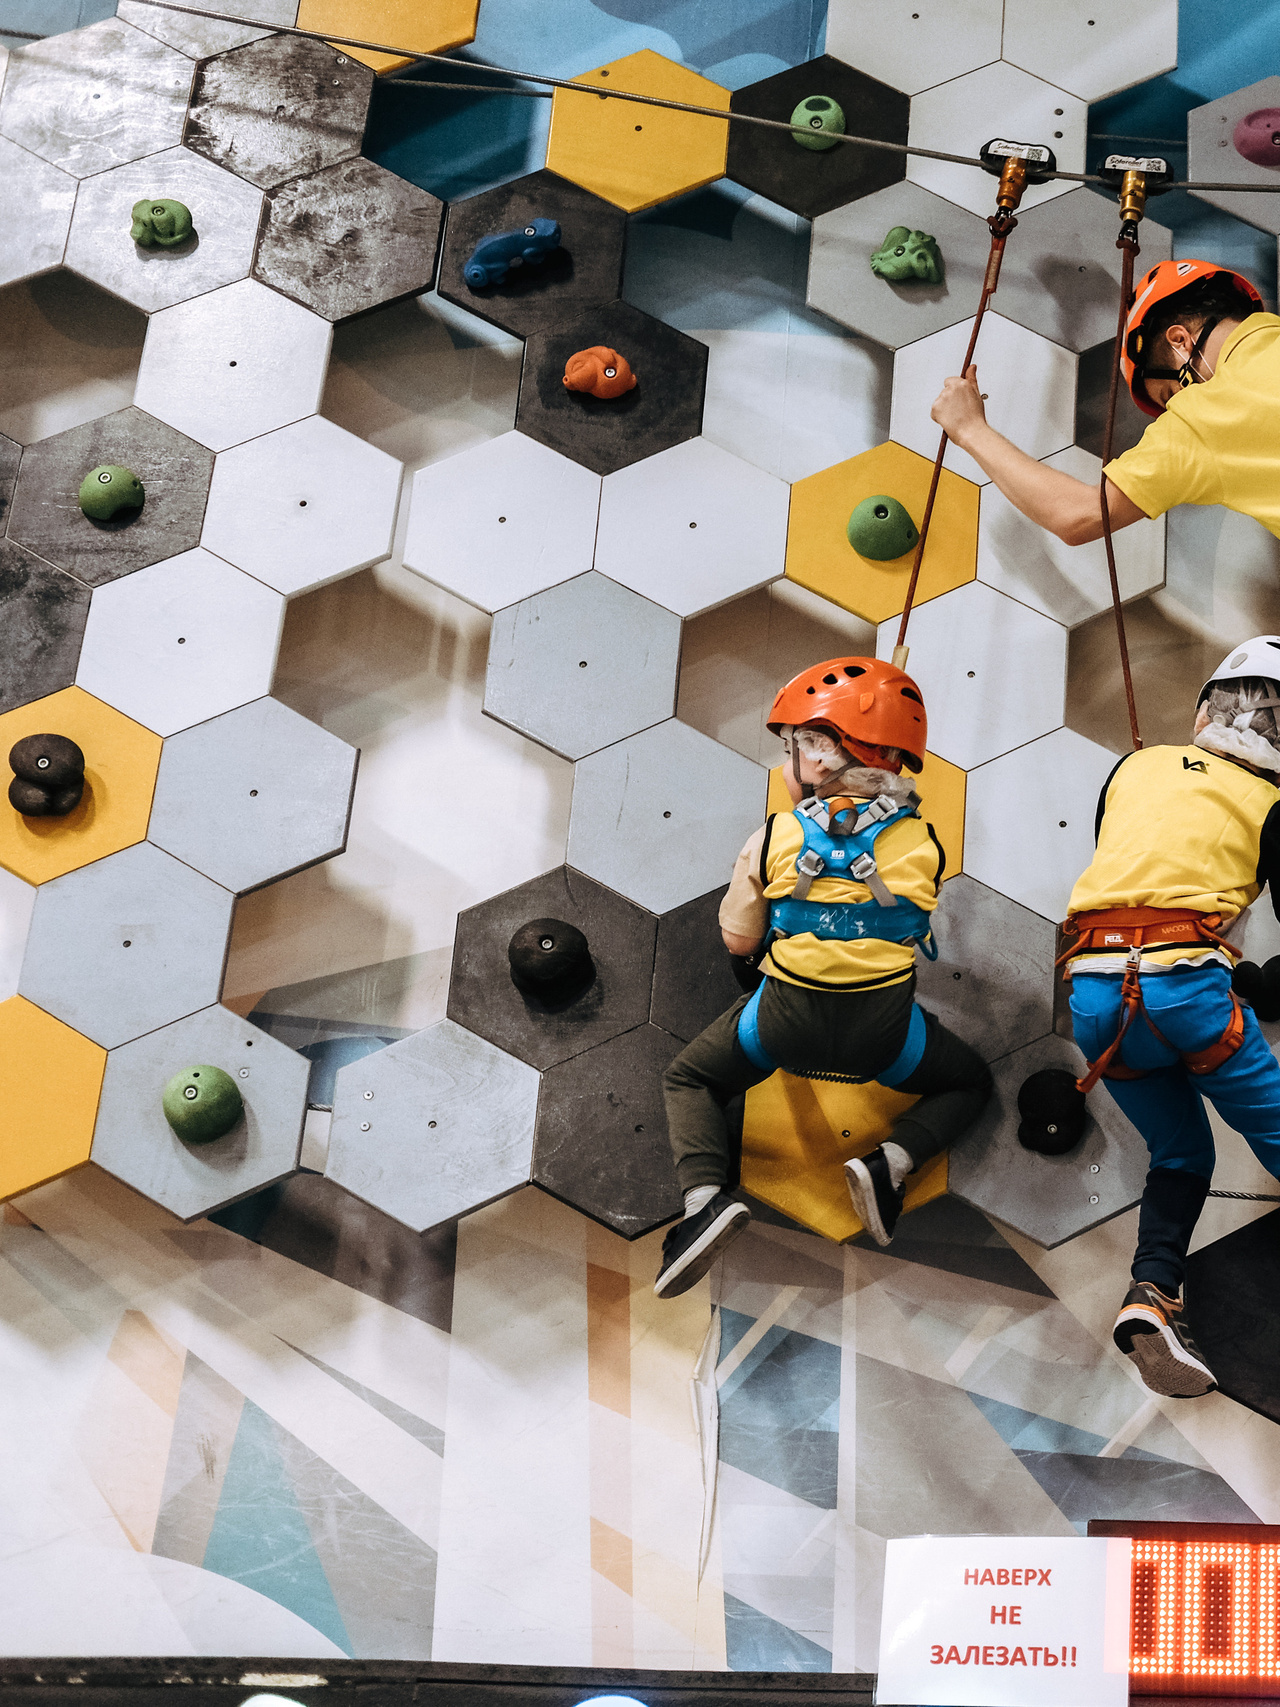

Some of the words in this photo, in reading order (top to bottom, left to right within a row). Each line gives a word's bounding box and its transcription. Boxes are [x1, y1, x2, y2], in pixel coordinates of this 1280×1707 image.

[963, 1568, 1052, 1586] НАВЕРХ
[990, 1605, 1022, 1625] НЕ
[930, 1645, 1077, 1668] ЗАЛЕЗАТЬ!!
